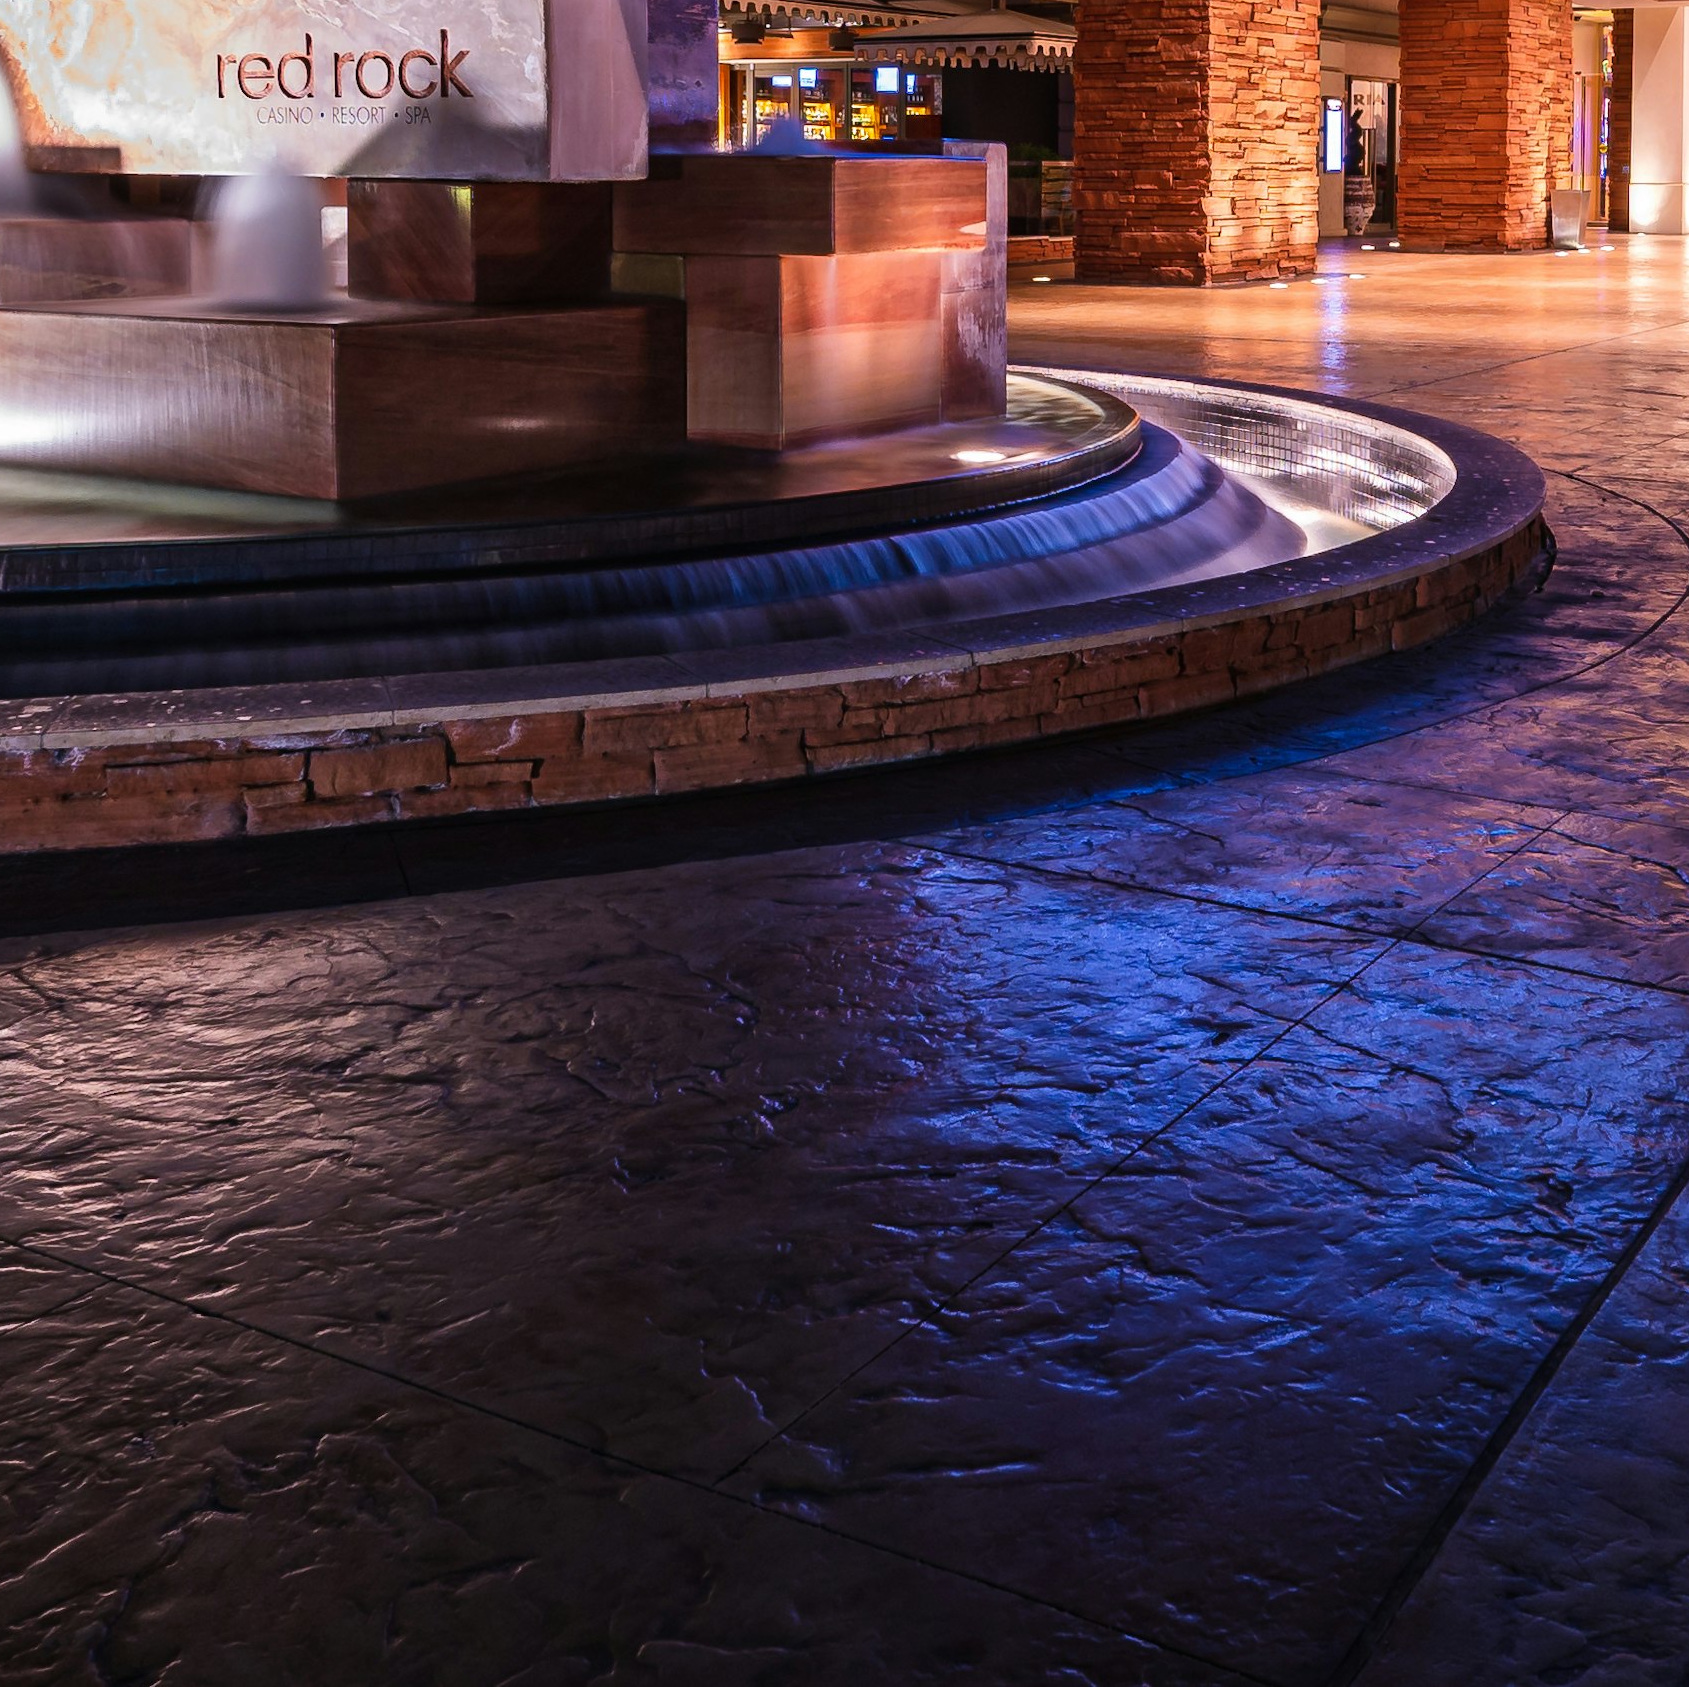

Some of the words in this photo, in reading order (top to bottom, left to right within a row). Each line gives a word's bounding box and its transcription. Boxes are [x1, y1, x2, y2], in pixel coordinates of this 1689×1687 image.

[216, 32, 315, 100] red
[333, 28, 474, 100] rock
[256, 106, 314, 125] CASINO
[332, 106, 387, 125] RESORT
[405, 106, 432, 125] SPA
